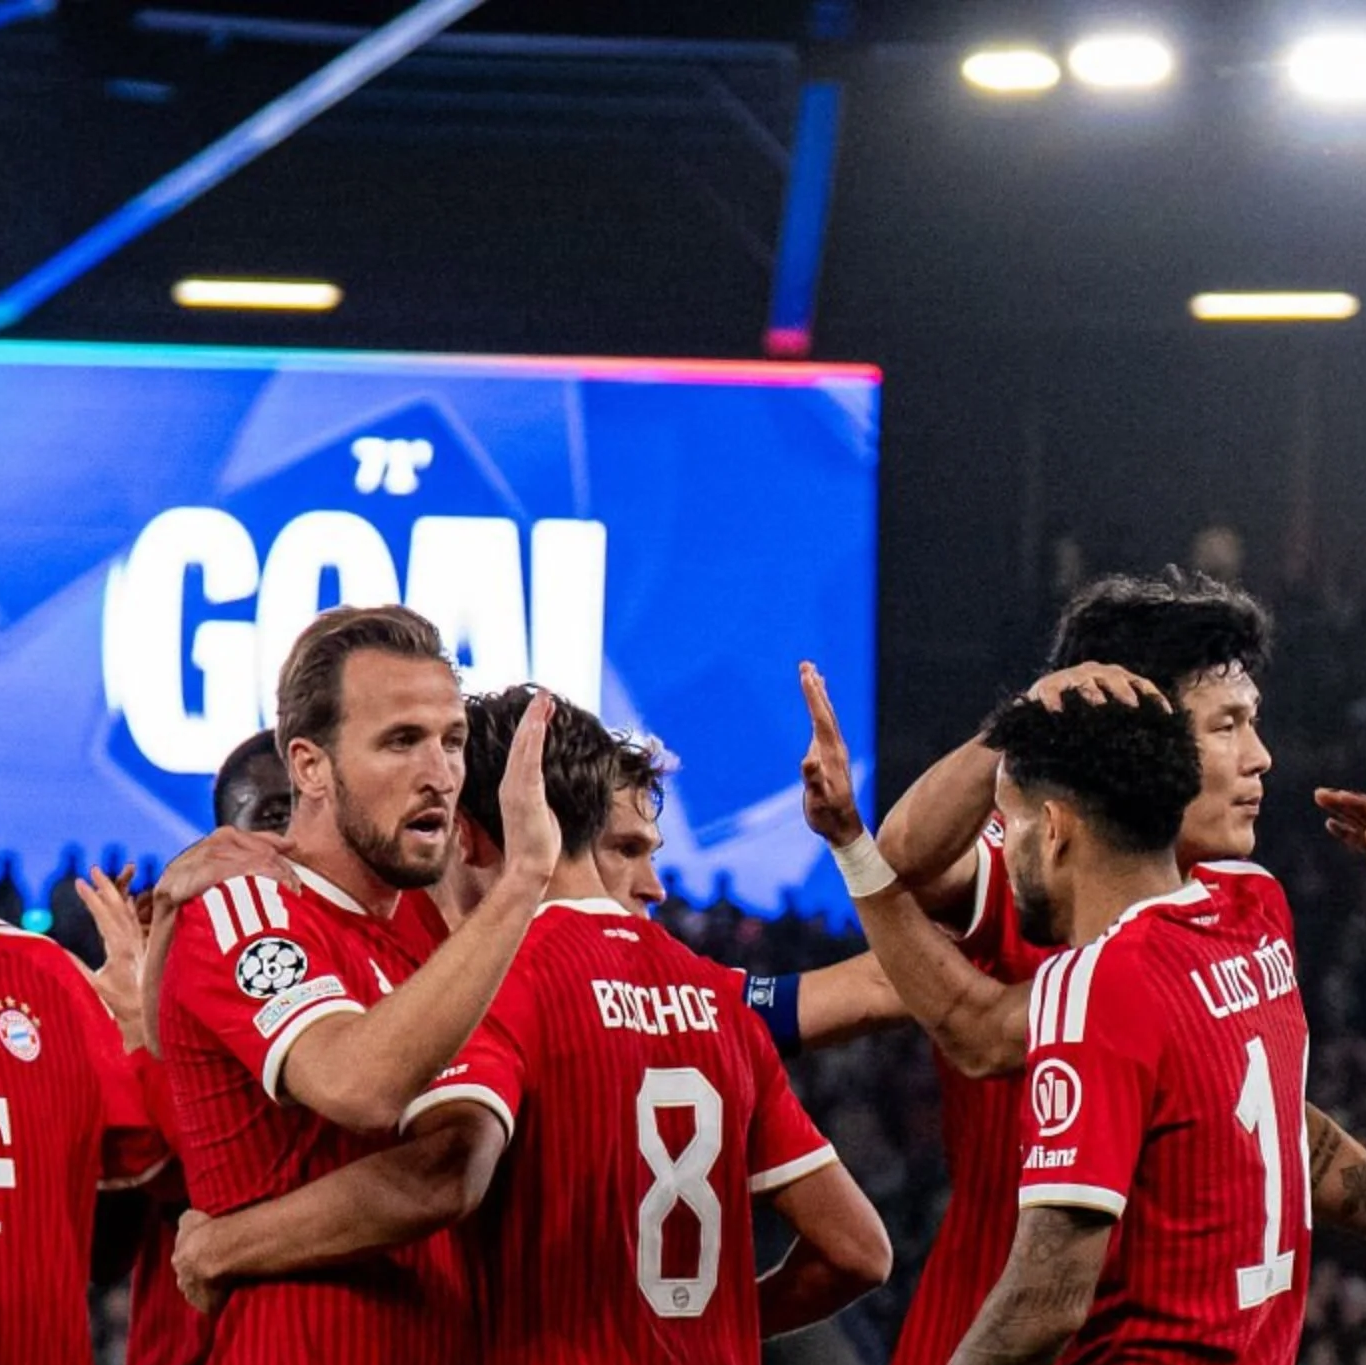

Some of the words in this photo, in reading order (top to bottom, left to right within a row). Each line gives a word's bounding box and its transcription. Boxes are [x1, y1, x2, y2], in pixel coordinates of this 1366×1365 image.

[1189, 955, 1260, 1019] LUIS
[636, 1067, 723, 1317] 8
[1235, 1034, 1312, 1310] 1
